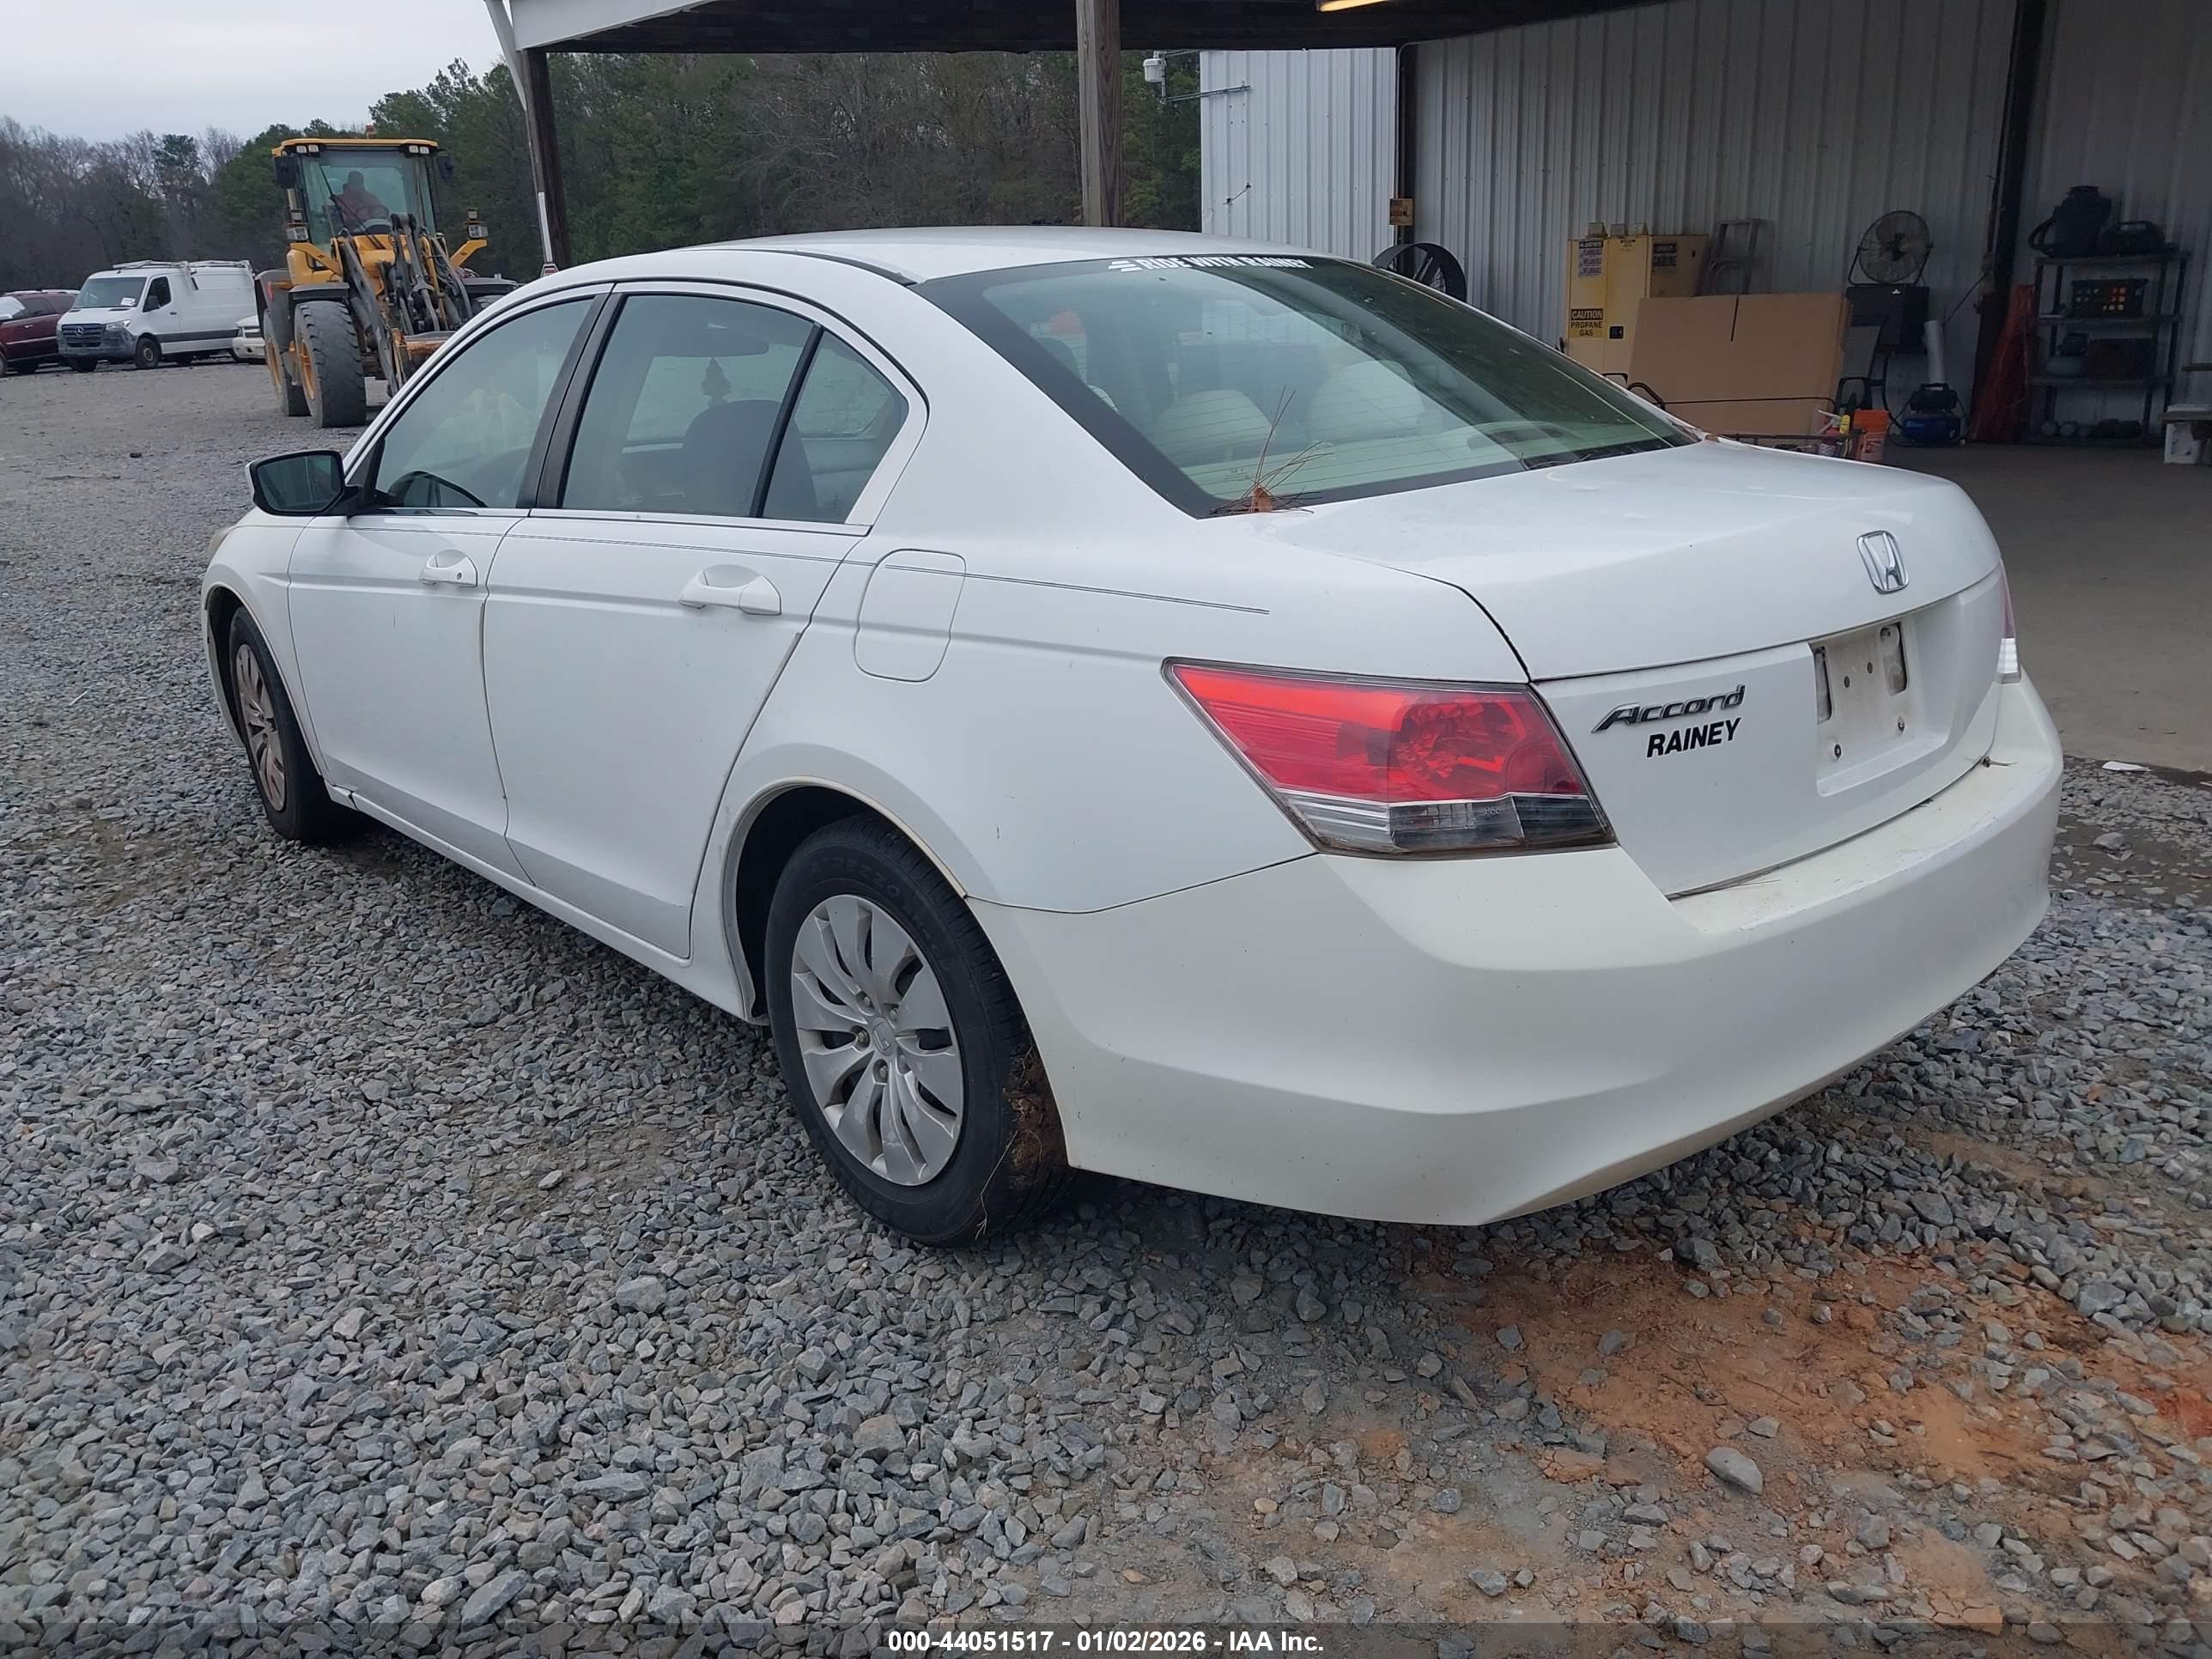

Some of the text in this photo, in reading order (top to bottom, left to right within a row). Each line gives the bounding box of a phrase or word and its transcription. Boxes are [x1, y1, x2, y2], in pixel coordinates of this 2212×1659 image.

[1134, 256, 1315, 270] RIDE WITH RAINEY
[1572, 310, 1602, 319] CAUTION
[1590, 684, 1746, 733] Accord
[1646, 717, 1742, 758] RAINEY
